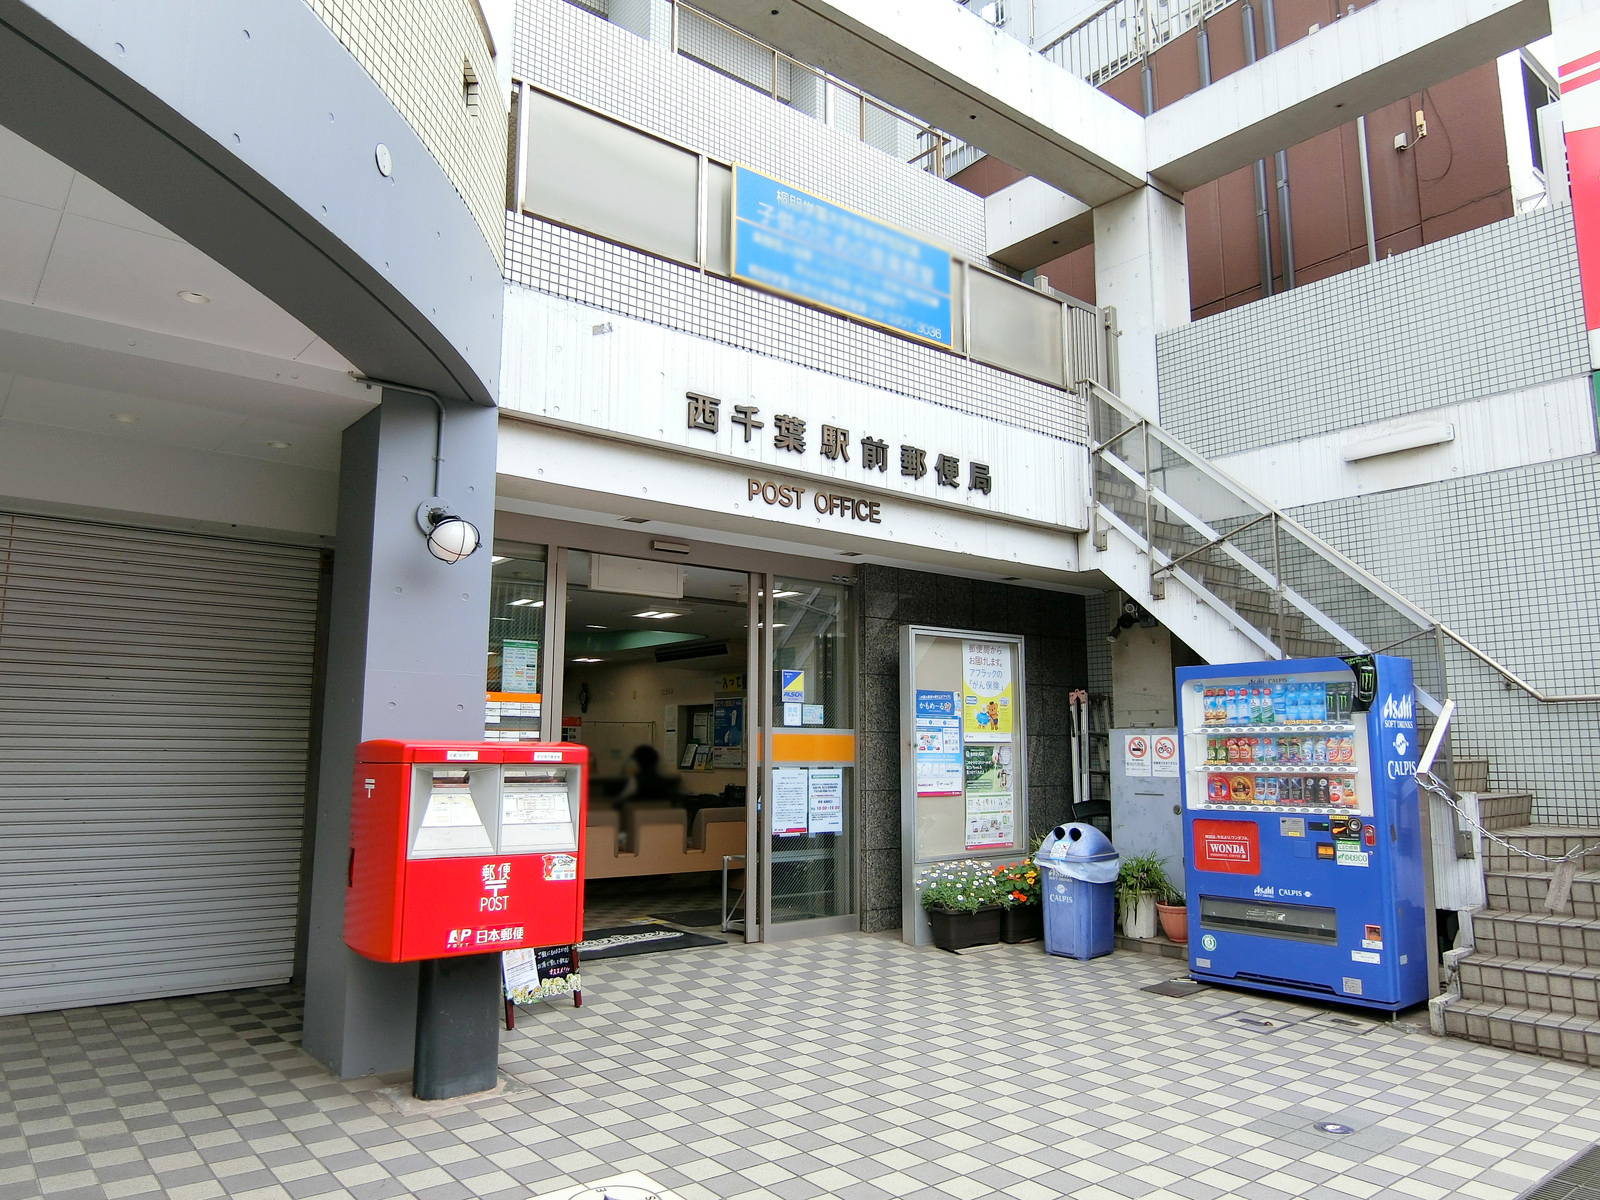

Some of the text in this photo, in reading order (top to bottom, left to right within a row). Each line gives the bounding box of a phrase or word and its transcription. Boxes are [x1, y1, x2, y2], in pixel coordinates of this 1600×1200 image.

[686, 391, 992, 495] 西千葉駅前郵便局
[747, 478, 881, 524] POST OFFICE
[968, 644, 1002, 654] 郵便局から
[969, 668, 1003, 678] アフラックの
[1384, 692, 1412, 719] Asahi
[1385, 720, 1413, 728] SOFT DRINKS
[1388, 760, 1416, 780] CALPIS
[1210, 844, 1246, 854] WONDA
[482, 863, 511, 881] 郵便
[1254, 885, 1274, 894] Asahi
[480, 896, 509, 912] POST
[1050, 894, 1073, 903] CALPIS
[476, 927, 524, 943] 日本郵便
